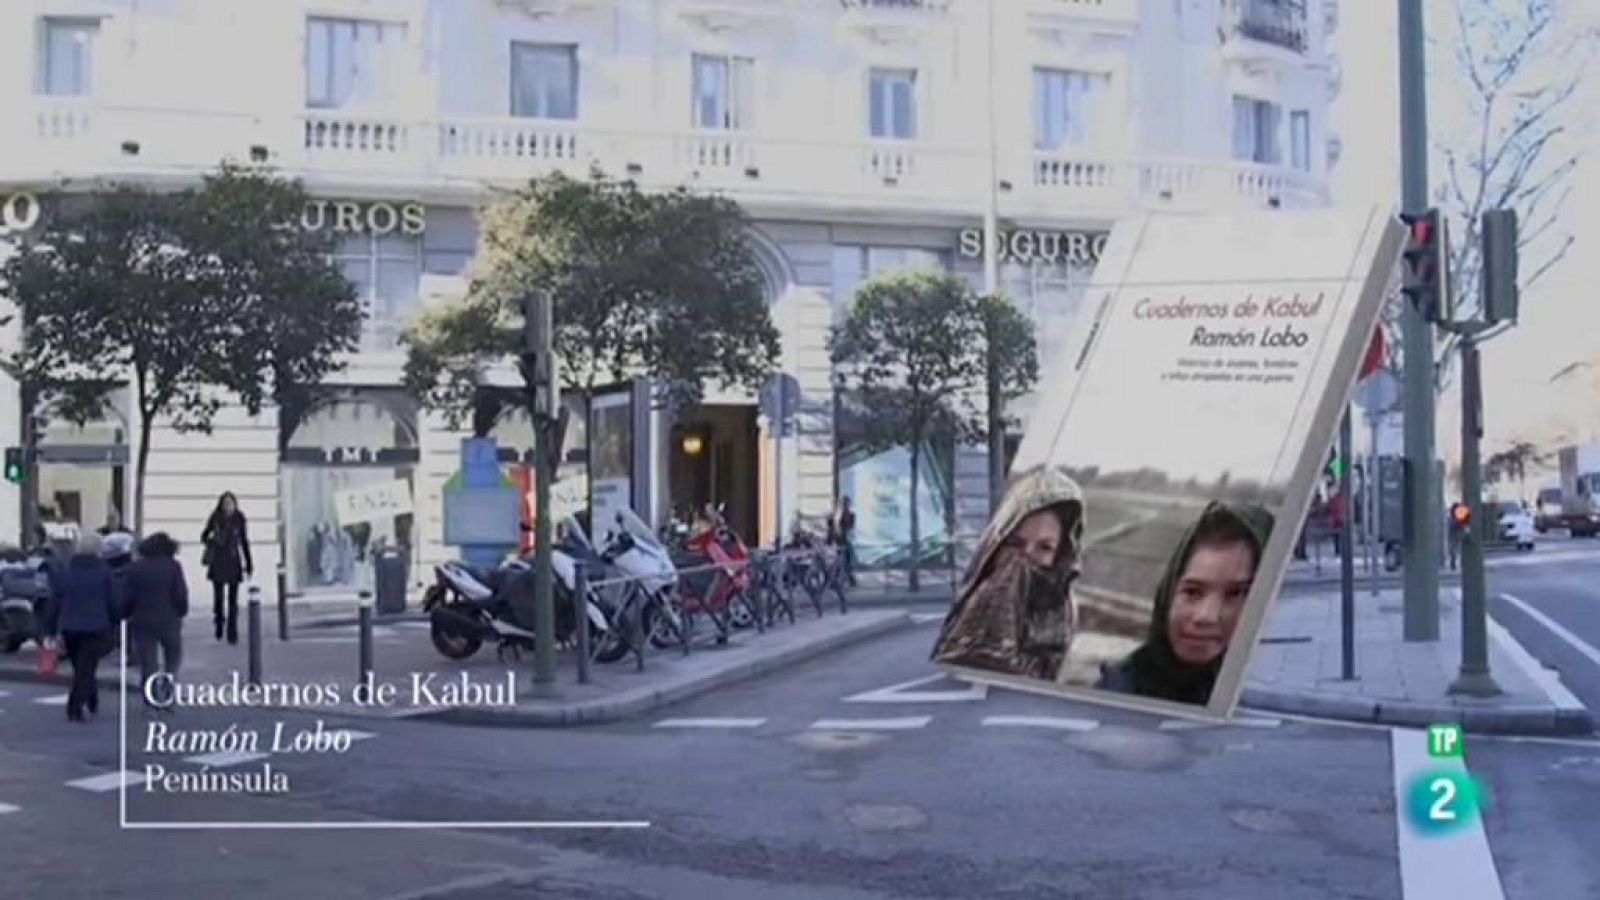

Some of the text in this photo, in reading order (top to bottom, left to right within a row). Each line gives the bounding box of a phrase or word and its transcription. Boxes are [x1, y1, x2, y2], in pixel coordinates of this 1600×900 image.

[298, 200, 426, 234] UROS
[1132, 291, 1325, 320] Cuadernos de Kabul
[1190, 324, 1309, 348] Ramón Lobo
